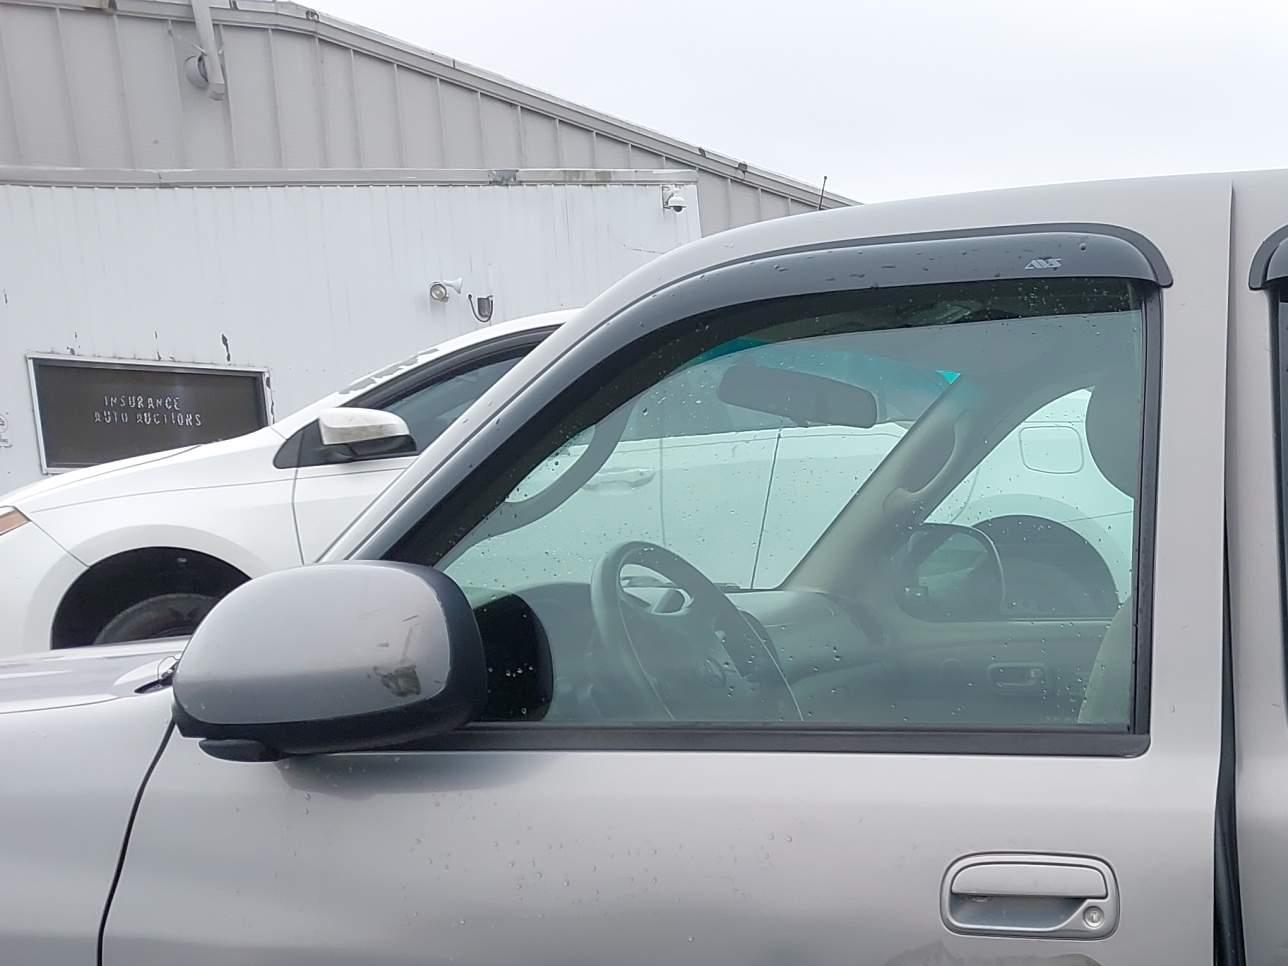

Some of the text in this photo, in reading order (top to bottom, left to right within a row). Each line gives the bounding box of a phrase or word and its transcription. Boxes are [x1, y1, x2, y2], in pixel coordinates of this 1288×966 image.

[104, 395, 181, 411] INSURANCE
[94, 410, 202, 426] AUTO AUCTIONS
